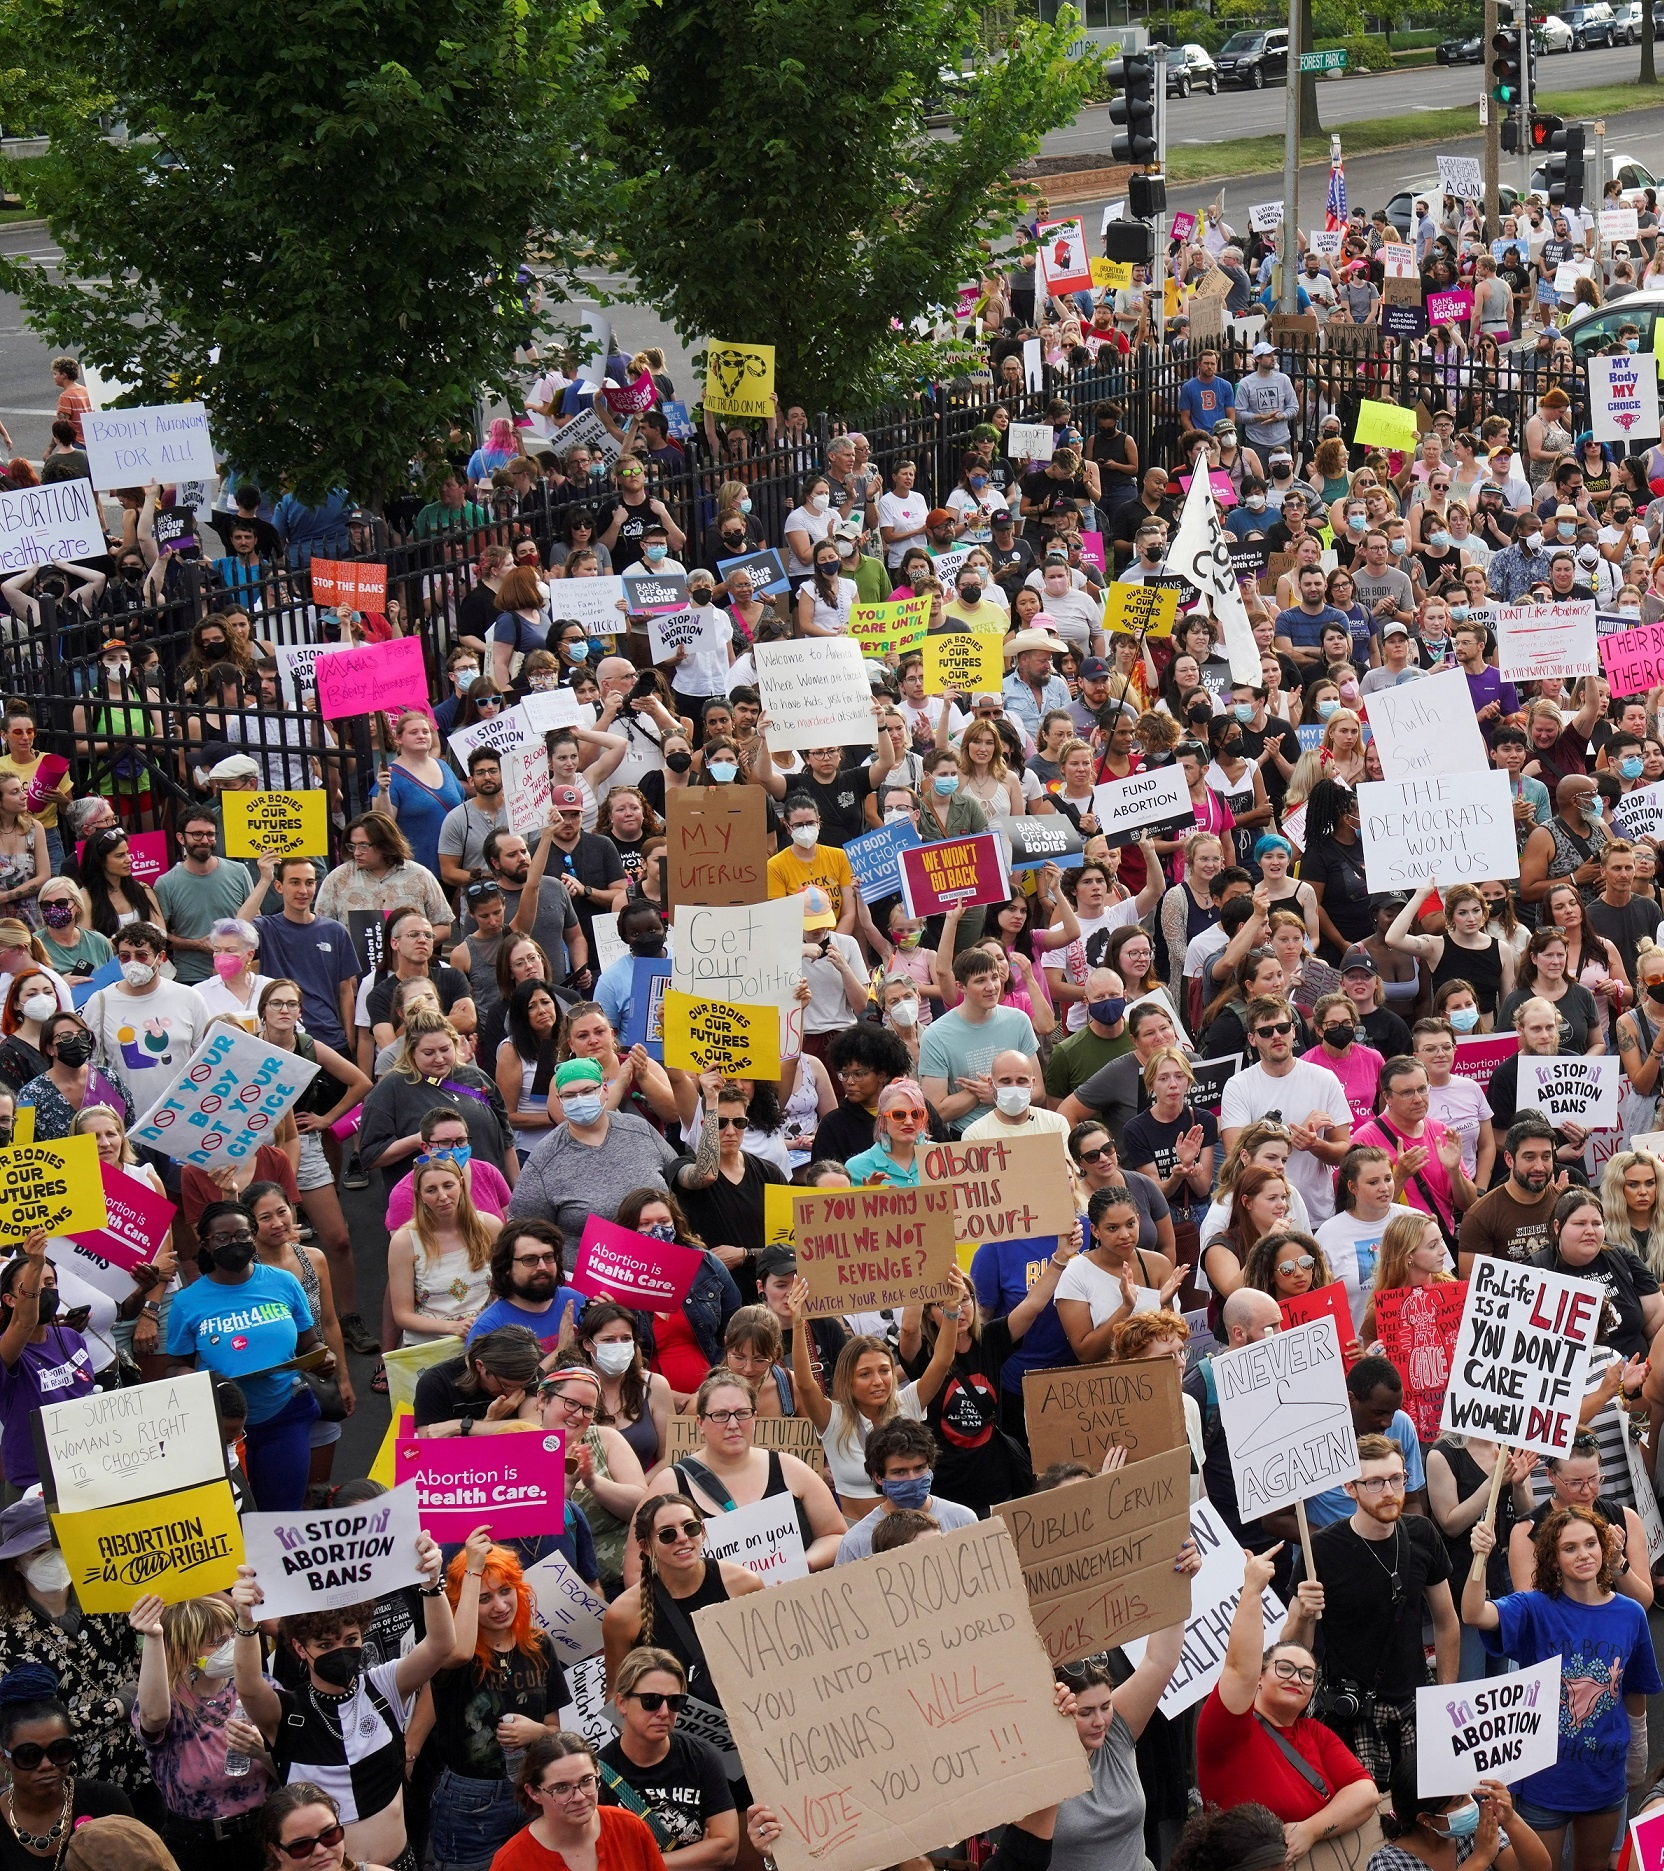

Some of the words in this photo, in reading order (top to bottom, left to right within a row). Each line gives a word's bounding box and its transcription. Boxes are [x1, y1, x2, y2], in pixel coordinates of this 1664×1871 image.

[1301, 55, 1323, 70] FOREST
[1326, 54, 1339, 66] PARK
[1440, 165, 1455, 176] MORE
[1457, 167, 1479, 178] RIGHTS
[1462, 159, 1476, 167] HAVE
[1446, 181, 1455, 193] A
[1457, 183, 1481, 196] GUN
[1258, 211, 1282, 223] ABORTION
[1263, 218, 1278, 226] BANS
[1432, 297, 1453, 306] BANS
[1434, 309, 1463, 319] BODIES
[1612, 358, 1631, 368] MY
[1609, 372, 1638, 384] Body
[1613, 384, 1635, 398] MY
[717, 397, 740, 413] TREAD
[741, 400, 754, 413] ON
[754, 401, 767, 414] ME
[1607, 400, 1641, 411] CHOICE
[92, 419, 147, 442] BODILY
[155, 412, 208, 434] AUTONOMY
[115, 446, 152, 470] FOR
[161, 440, 192, 463] ALL!
[312, 577, 335, 588] STOP
[337, 580, 355, 592] THE
[358, 582, 384, 594] BANS
[1600, 633, 1649, 661] THEIR
[1611, 661, 1656, 690] THEIR
[1121, 780, 1158, 798] FUND
[1112, 791, 1178, 819] ABORTION
[682, 822, 732, 853] MY
[921, 848, 946, 872] WE
[946, 843, 978, 868] WON'T
[679, 864, 758, 889] UTERUS
[930, 868, 948, 892] GO
[948, 864, 980, 890] BACK
[925, 1140, 1012, 1180] abort
[952, 1178, 1002, 1210] THIS
[1476, 1262, 1535, 1305] ProLife
[1497, 1302, 1510, 1320] a
[1529, 1283, 1597, 1341] LIE
[1468, 1317, 1506, 1360] YOU
[1511, 1329, 1586, 1378] DON'T
[1221, 1324, 1334, 1400] NEVER
[1464, 1358, 1528, 1400] CARE
[1539, 1378, 1571, 1406] IF
[1450, 1392, 1524, 1435] WOMEN
[1525, 1405, 1571, 1448] DIE
[1243, 1426, 1355, 1513] AGAIN
[304, 1516, 368, 1544] STOP
[280, 1535, 395, 1578] ABORTION
[307, 1562, 372, 1591] BANS
[716, 1583, 870, 1678] VAGINAS
[876, 1531, 1014, 1629] BROUGHT
[743, 1688, 797, 1732] YOU
[813, 1661, 873, 1702] INTO
[874, 1639, 932, 1672] THIS
[941, 1613, 1016, 1650] WORLD
[1474, 1685, 1526, 1712] STOP
[1451, 1710, 1542, 1757] ABORTION
[1474, 1737, 1524, 1773] BANS
